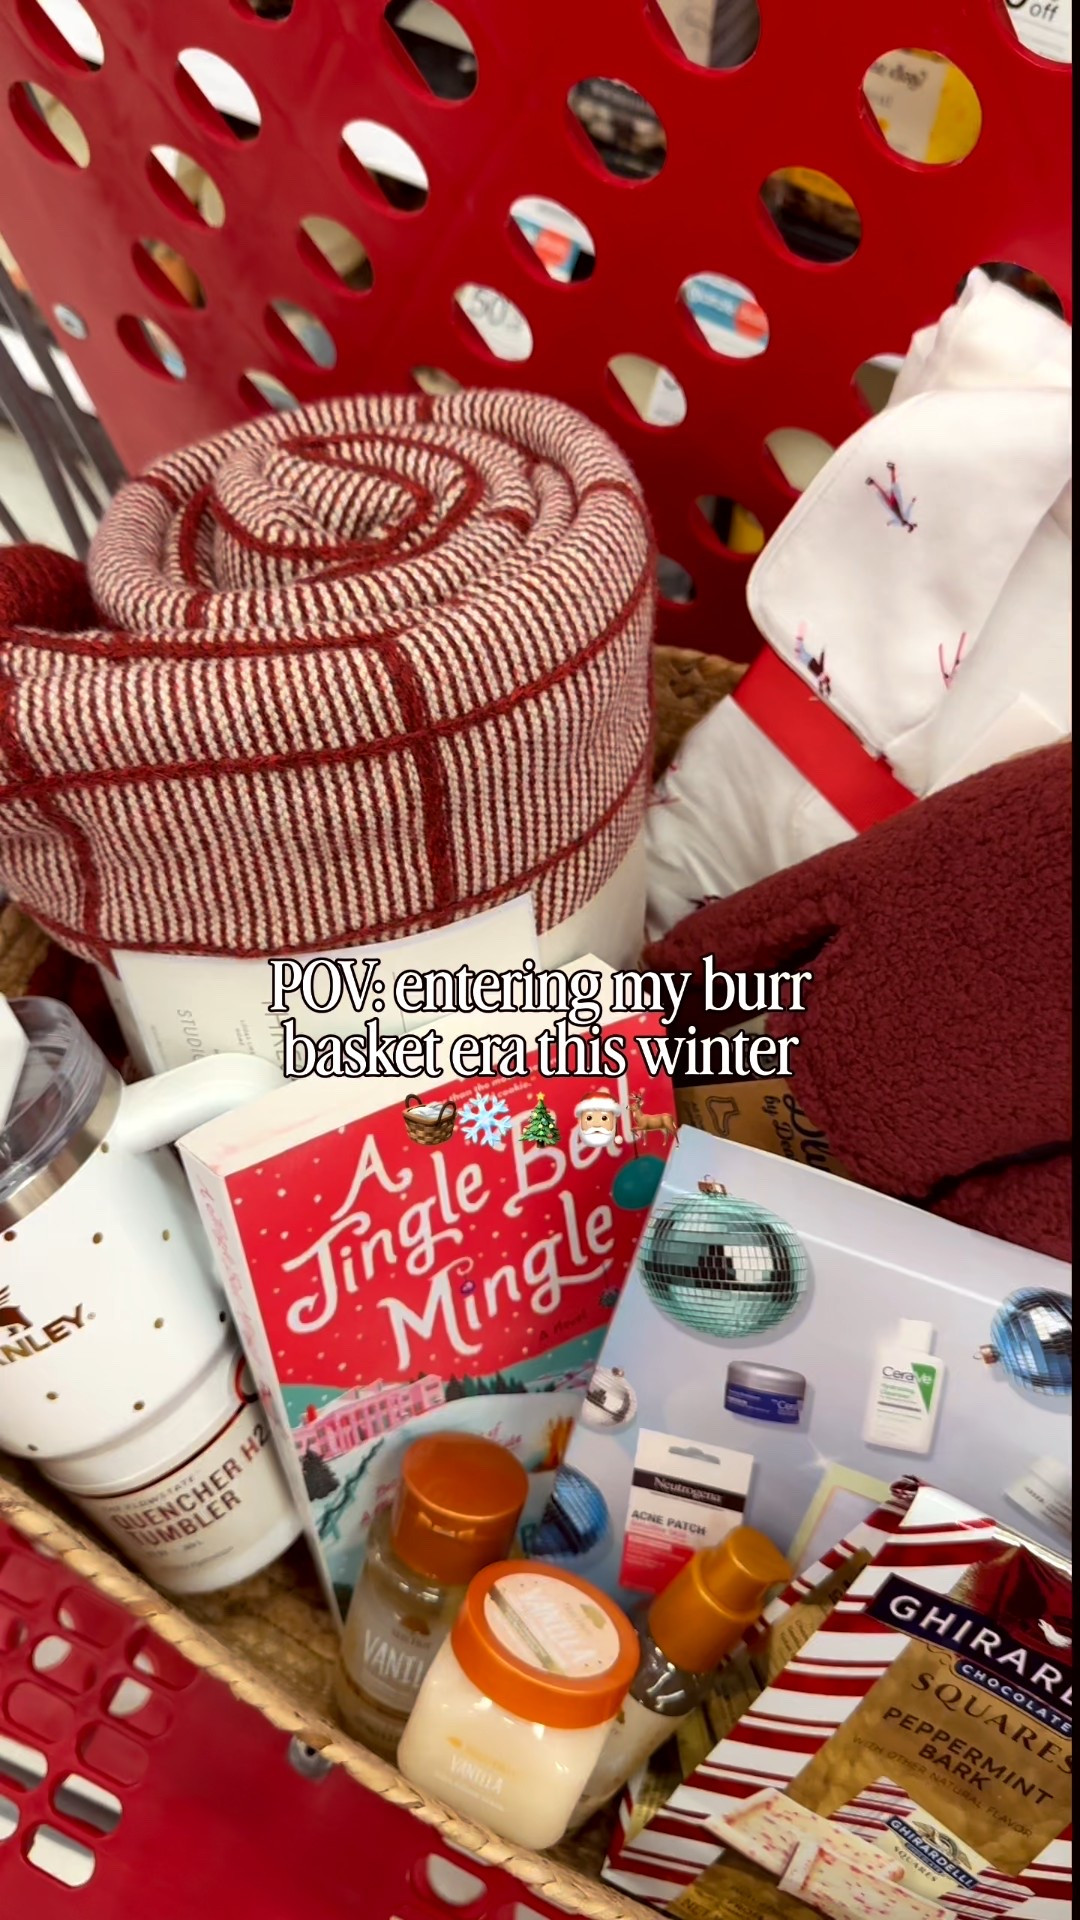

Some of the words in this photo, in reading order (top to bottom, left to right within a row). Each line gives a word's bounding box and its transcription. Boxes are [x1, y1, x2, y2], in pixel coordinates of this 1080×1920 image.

[1029, 3, 1059, 21] off
[762, 1095, 780, 1116] by
[330, 1133, 414, 1222] A
[281, 1150, 491, 1333] Jingle
[377, 1190, 615, 1372] Mingle
[0, 1302, 84, 1366] NLEY
[111, 1457, 243, 1531] QUENCHER
[126, 1489, 242, 1546] TUMBLER
[631, 1510, 665, 1525] ACNE
[667, 1517, 707, 1536] PATCH
[654, 1476, 722, 1503] Neutrogena
[961, 1664, 1071, 1733] CHOCOLATE
[852, 1736, 884, 1757] WITH
[887, 1751, 928, 1774] OTHER
[930, 1771, 982, 1810] NATURAL
[986, 1805, 1034, 1839] FLAVOR
[882, 1706, 1054, 1806] PEPPERMINT
[917, 1743, 992, 1792] BARK
[890, 1819, 974, 1888] GHIRARDELLI
